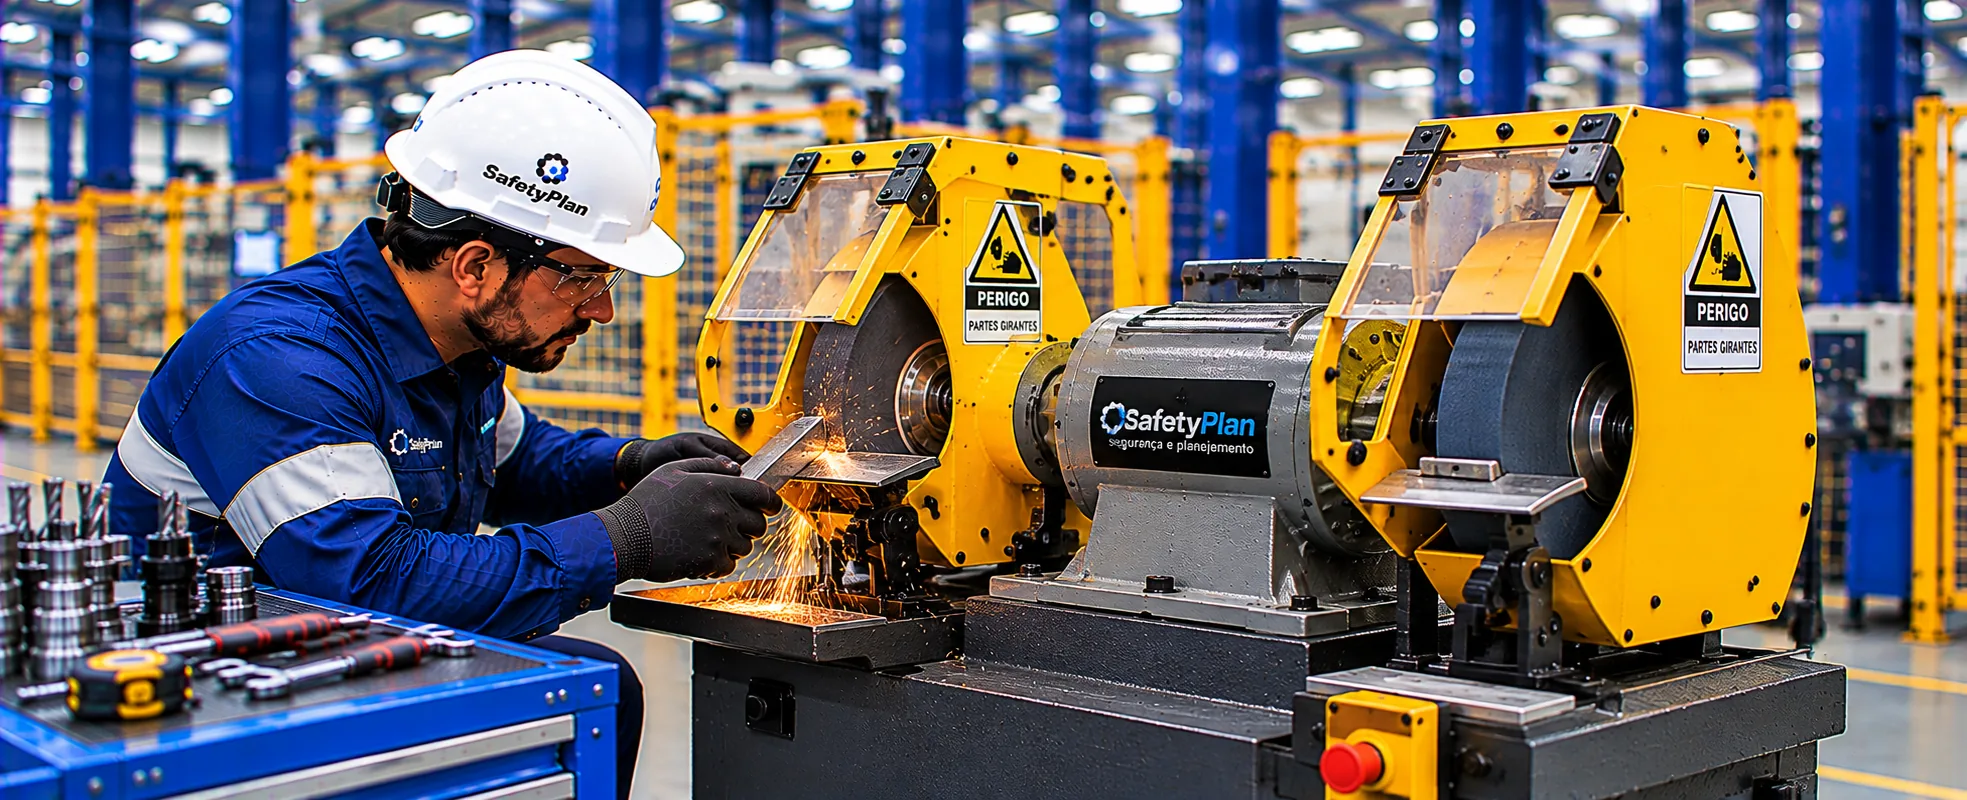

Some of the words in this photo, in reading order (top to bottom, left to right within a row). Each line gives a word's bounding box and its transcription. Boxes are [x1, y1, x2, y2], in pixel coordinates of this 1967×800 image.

[482, 164, 589, 217] SafetyPlan
[977, 291, 1029, 307] PERIGO
[1697, 302, 1749, 321] PERIGO
[968, 320, 999, 331] PARTES
[1688, 340, 1718, 354] PARTES
[1124, 408, 1255, 439] SafetyPlan
[1166, 441, 1174, 450] e
